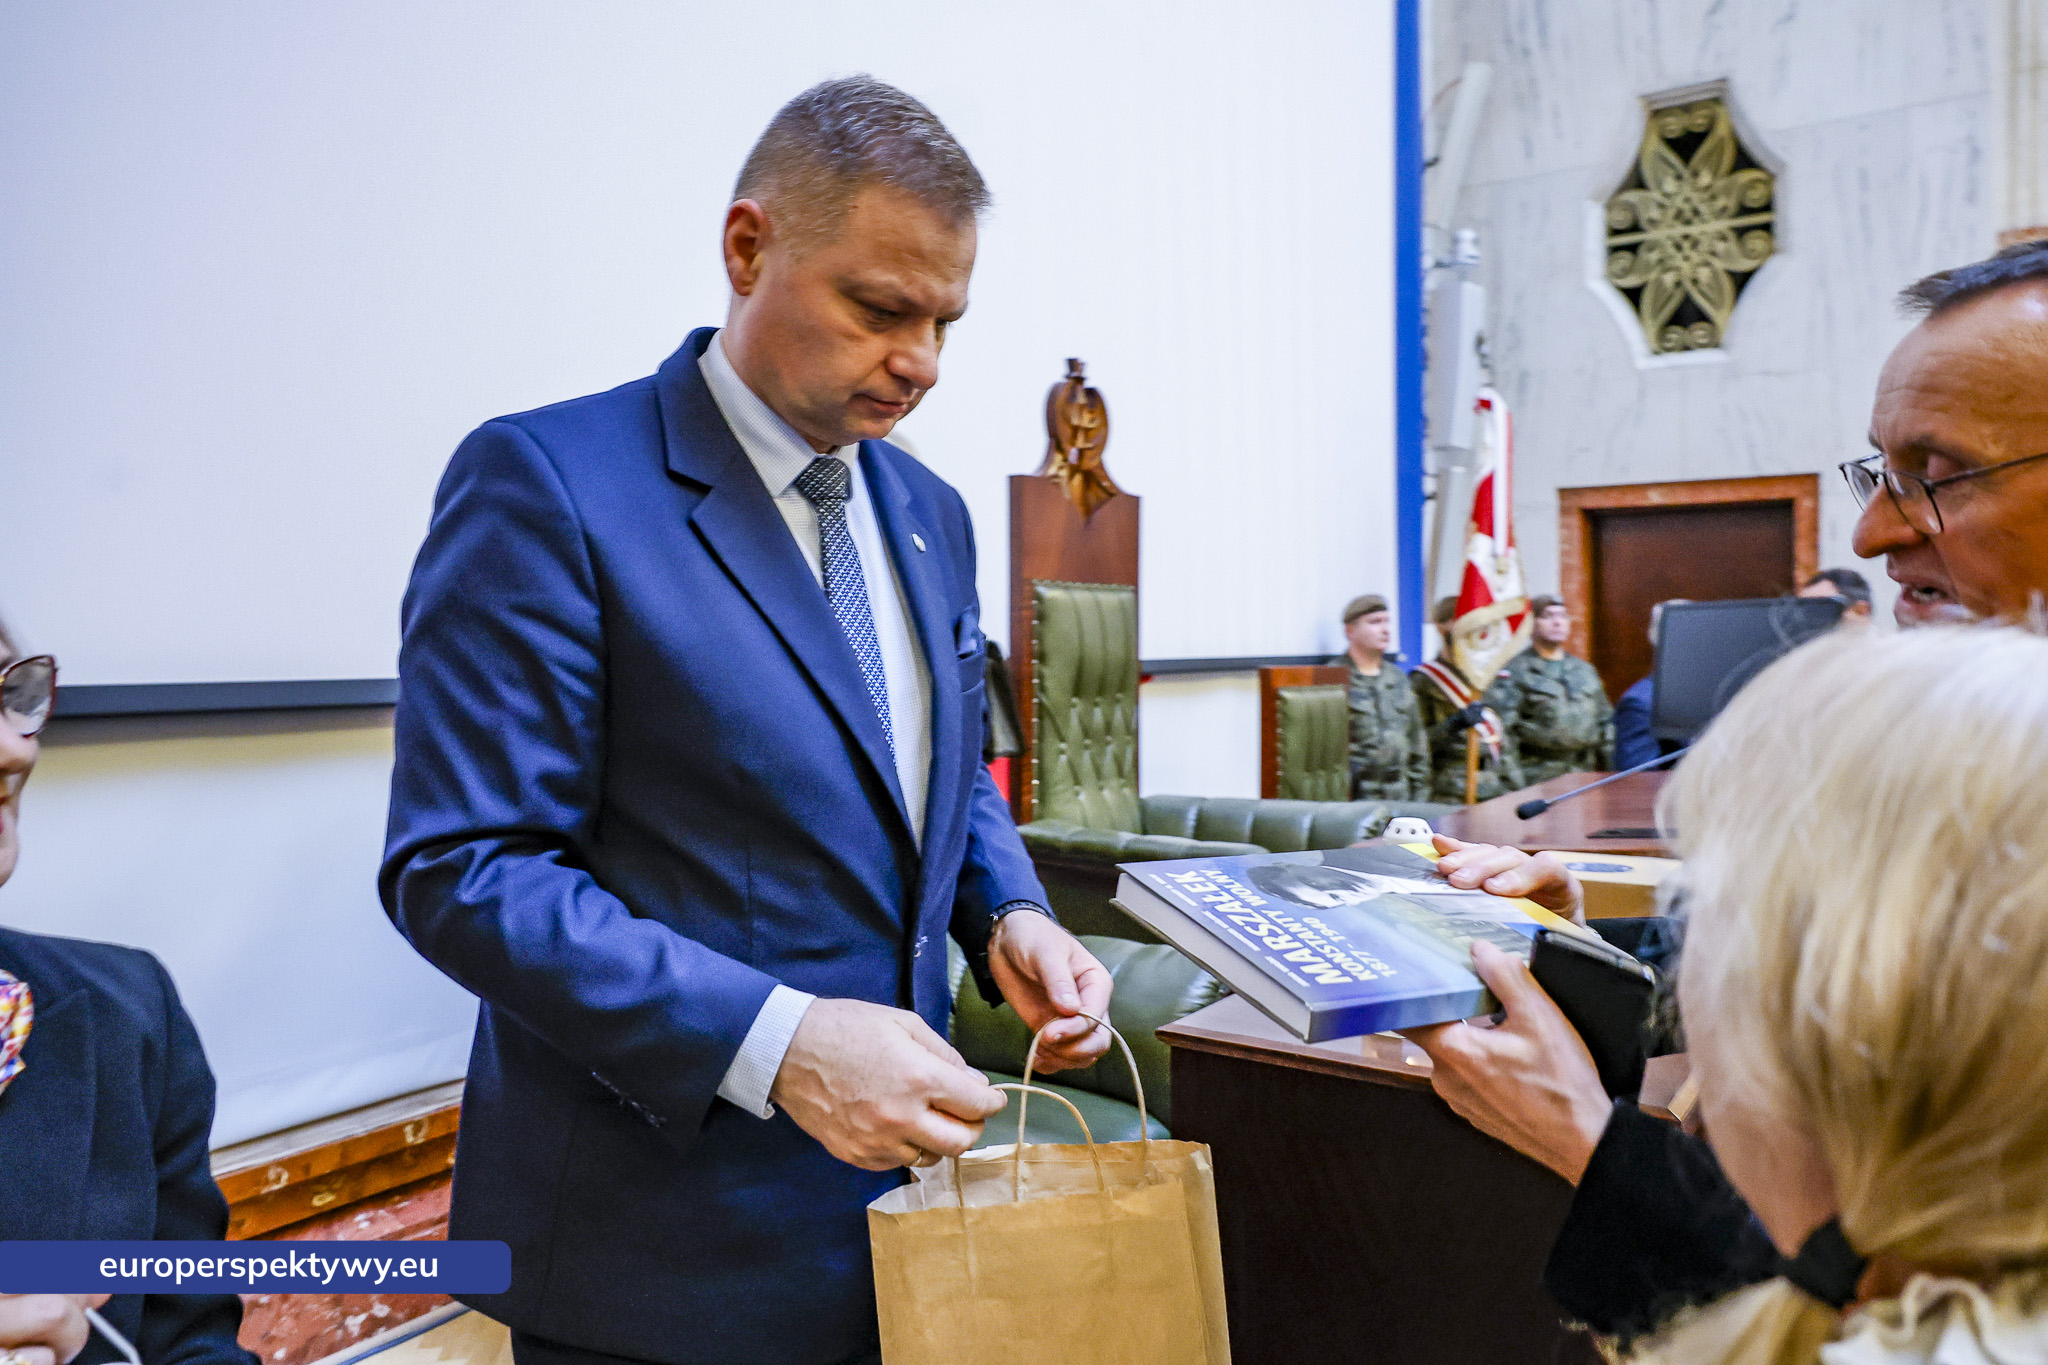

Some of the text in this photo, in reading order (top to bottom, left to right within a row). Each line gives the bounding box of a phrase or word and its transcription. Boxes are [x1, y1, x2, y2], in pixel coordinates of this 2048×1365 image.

[1199, 869, 1269, 907] WOLNY
[1164, 870, 1354, 985] MARSZAŁEK
[1260, 910, 1379, 981] KONSTANTY
[1302, 917, 1346, 942] 1940
[1349, 950, 1397, 978] 1877
